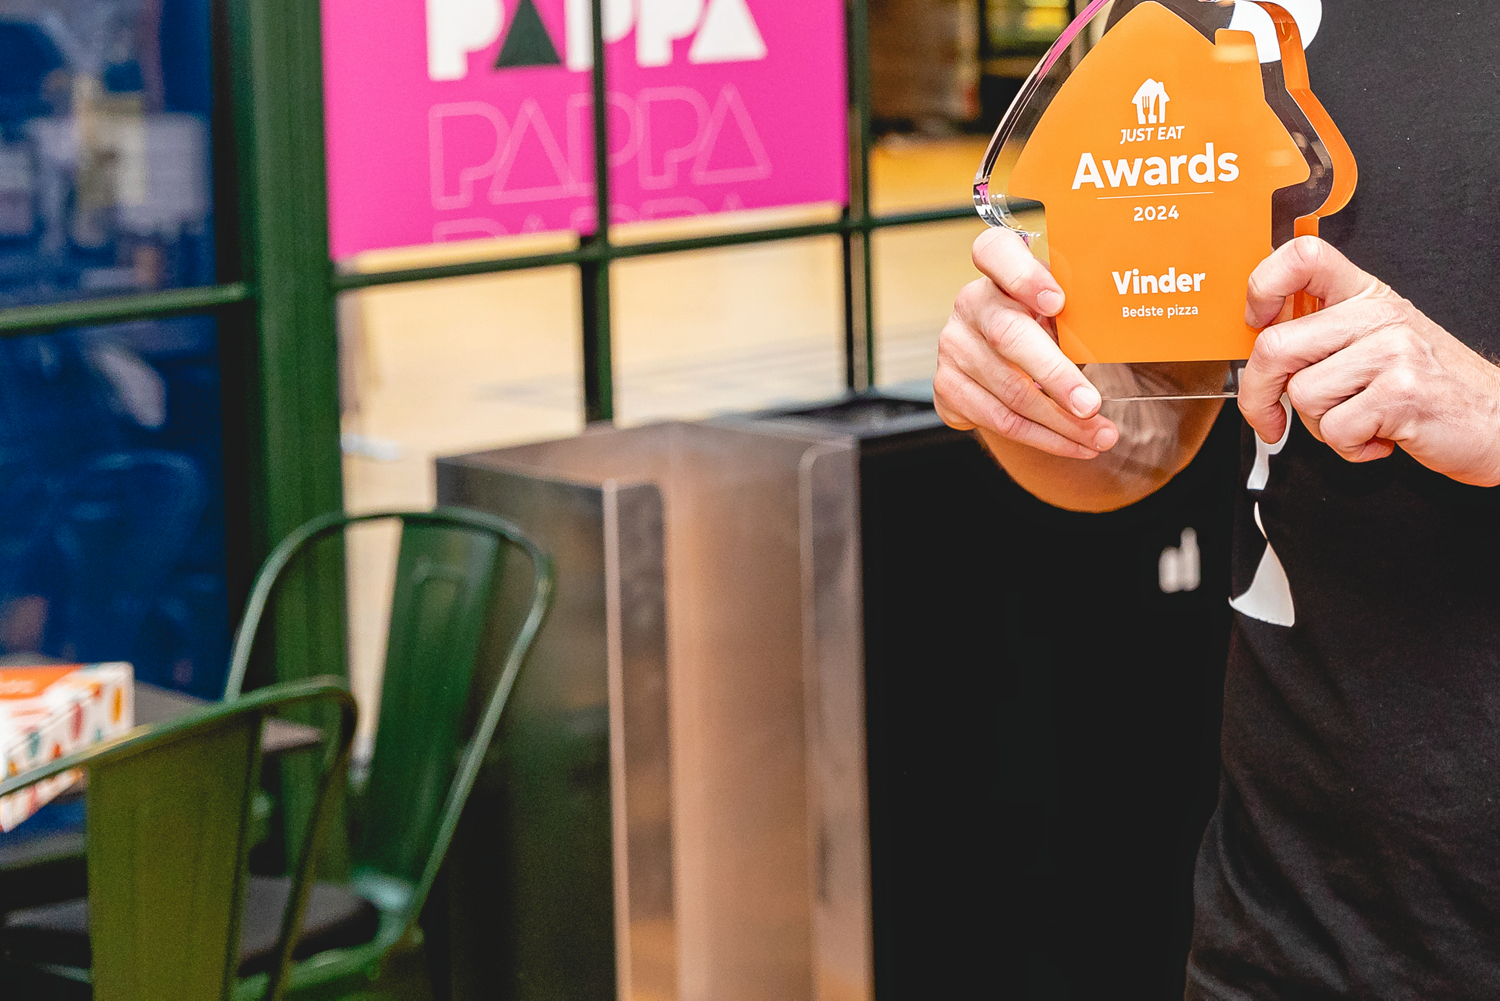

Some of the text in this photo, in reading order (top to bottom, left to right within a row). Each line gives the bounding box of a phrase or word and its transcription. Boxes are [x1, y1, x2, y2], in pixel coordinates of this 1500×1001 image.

[428, 83, 773, 210] PAPPA
[1120, 125, 1185, 145] JUST EAT
[1071, 142, 1240, 190] Awards
[1133, 205, 1179, 221] 2024
[1112, 267, 1206, 295] Vinder
[1122, 304, 1199, 319] Bedste pizza
